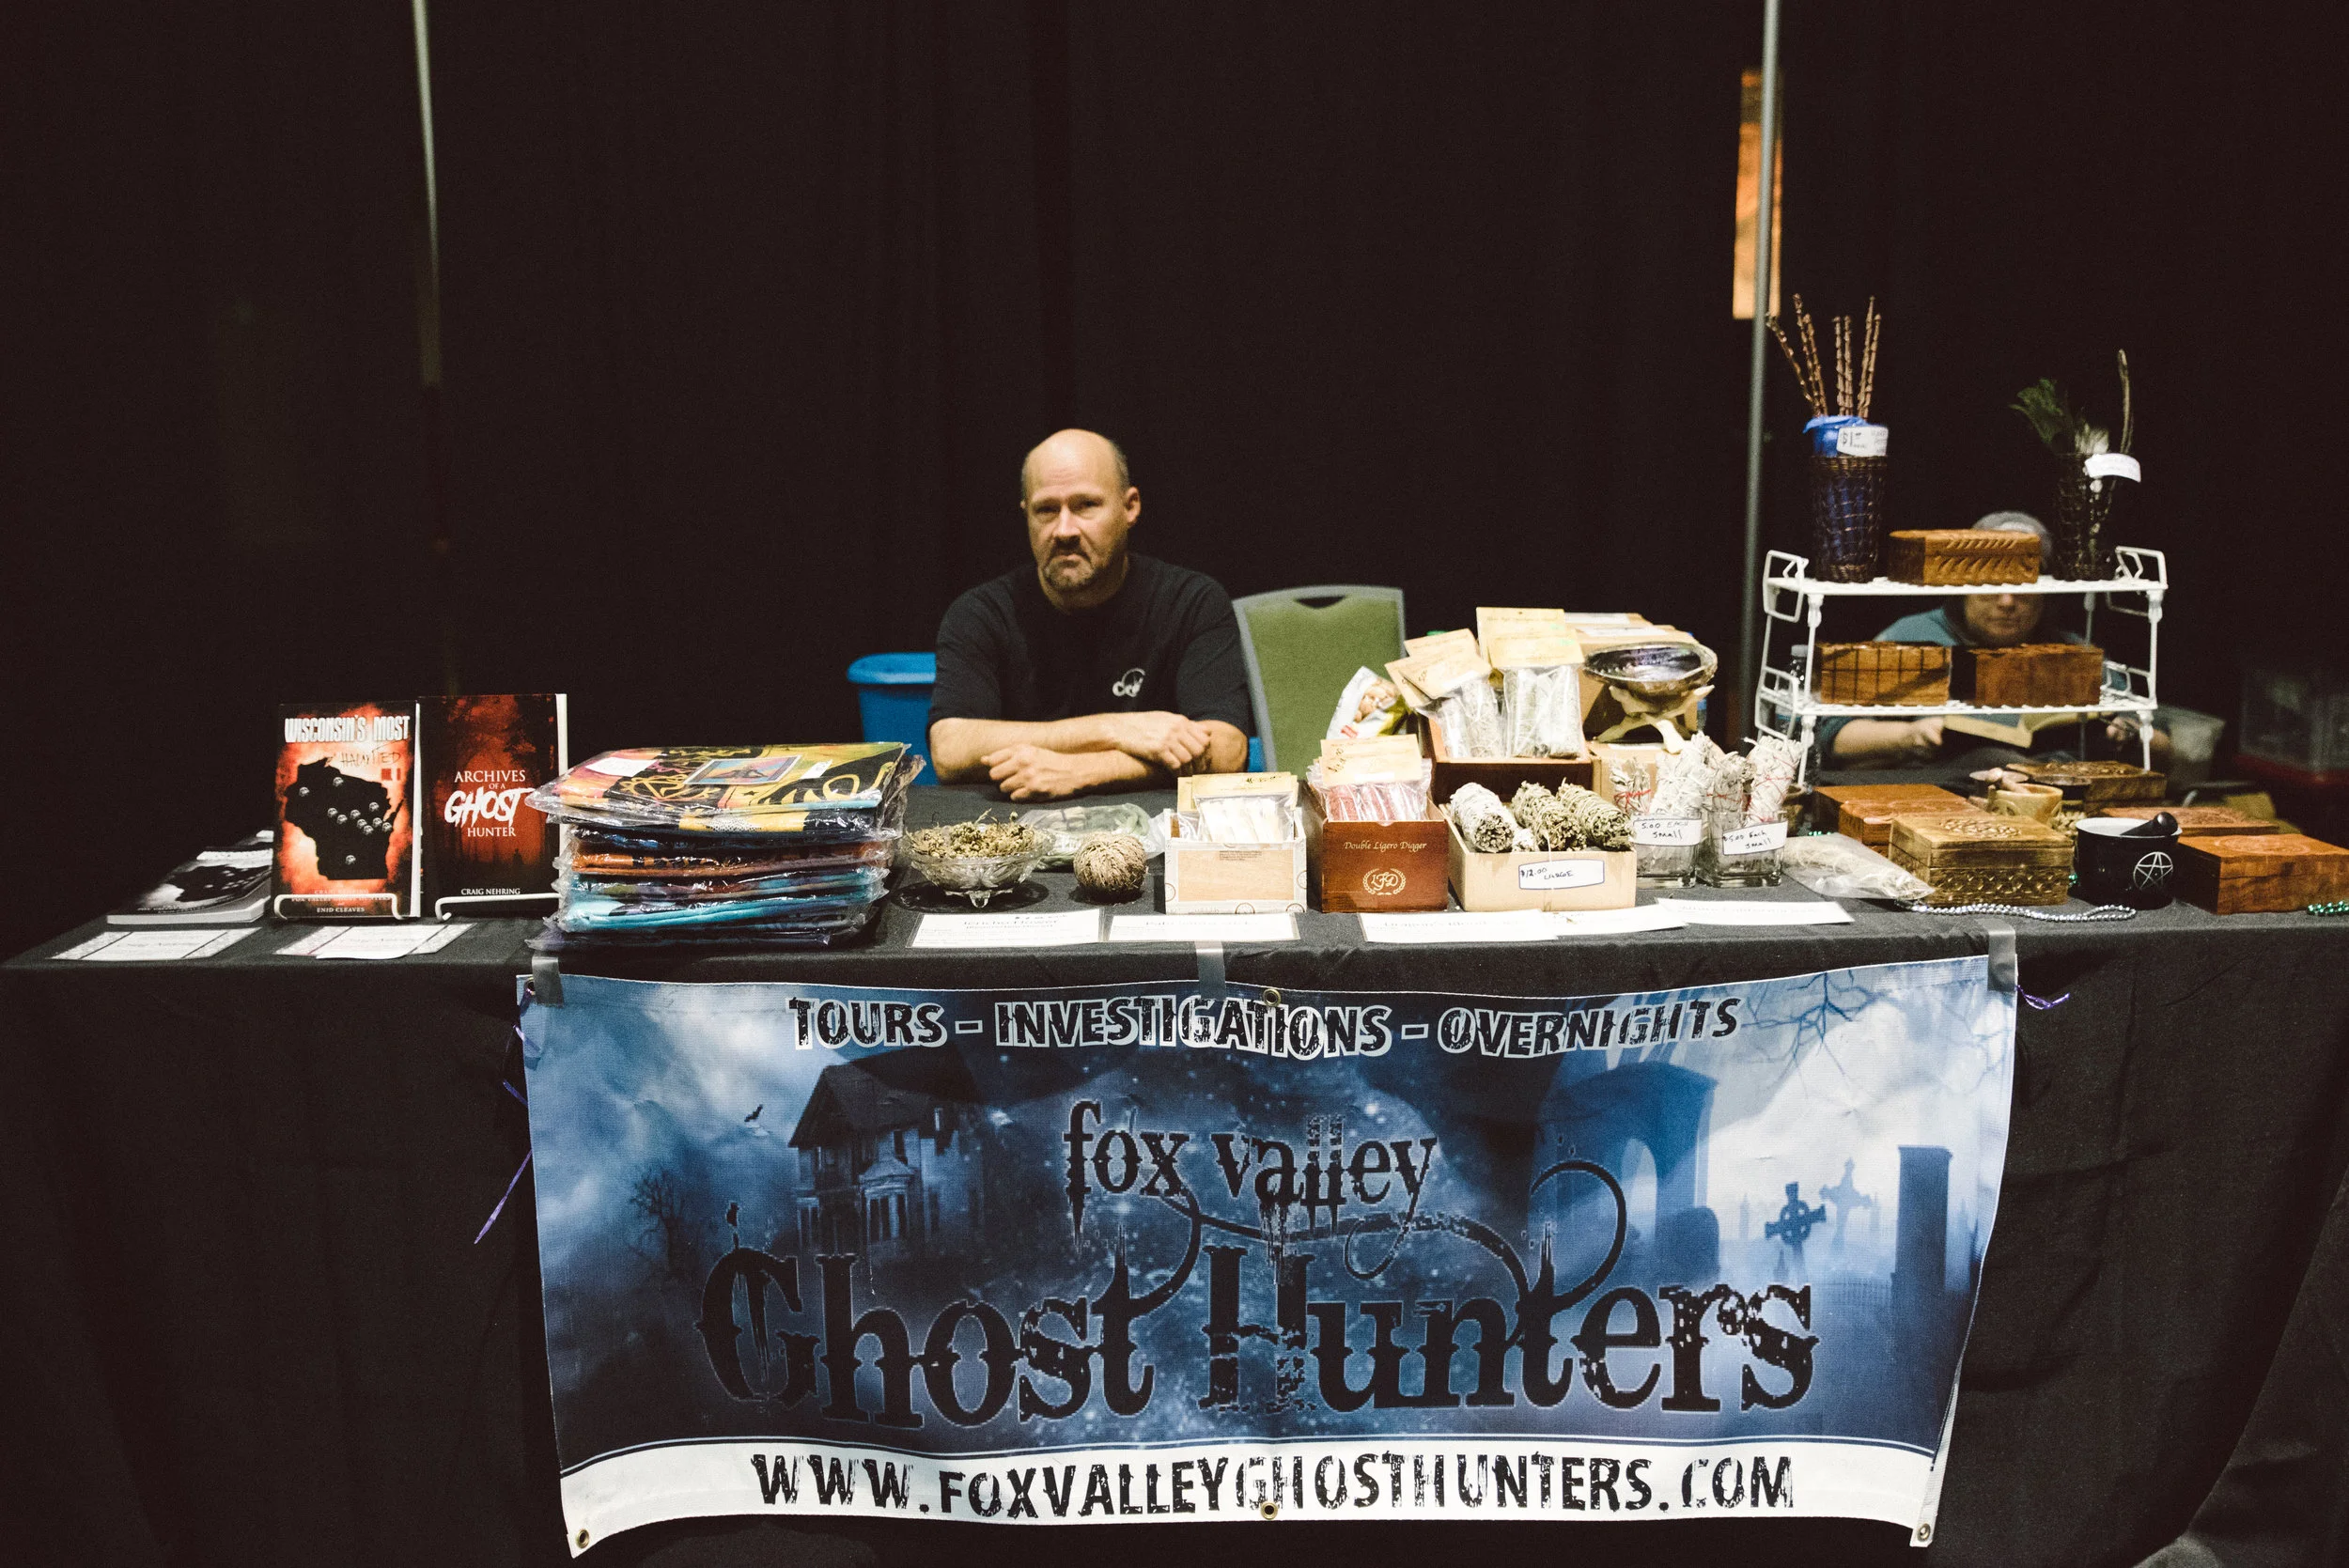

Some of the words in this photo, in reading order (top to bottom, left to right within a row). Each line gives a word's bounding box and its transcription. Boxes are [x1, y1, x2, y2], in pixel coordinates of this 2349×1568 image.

[285, 715, 366, 743] WISCONSIN'S
[373, 716, 411, 741] MOST
[340, 751, 402, 768] HAUNTED
[454, 769, 526, 783] ARCHIVES
[443, 786, 537, 828] GHOST
[467, 827, 517, 837] HUNTER
[1344, 840, 1372, 850] Double
[1373, 842, 1398, 853] Ligero
[1399, 841, 1427, 853] Digger
[786, 996, 947, 1049] TOURS
[994, 994, 1392, 1061] INVESTIGATIONS
[1436, 996, 1745, 1060] OVERNIGHTS
[1064, 1100, 1191, 1221] fox
[1211, 1115, 1439, 1276] valley
[697, 1229, 1179, 1429] Ghost
[1195, 1219, 1821, 1414] Hunters
[751, 1452, 1795, 1520] WWW.FOXVALLEYGHOSTHUNTERS.COM
